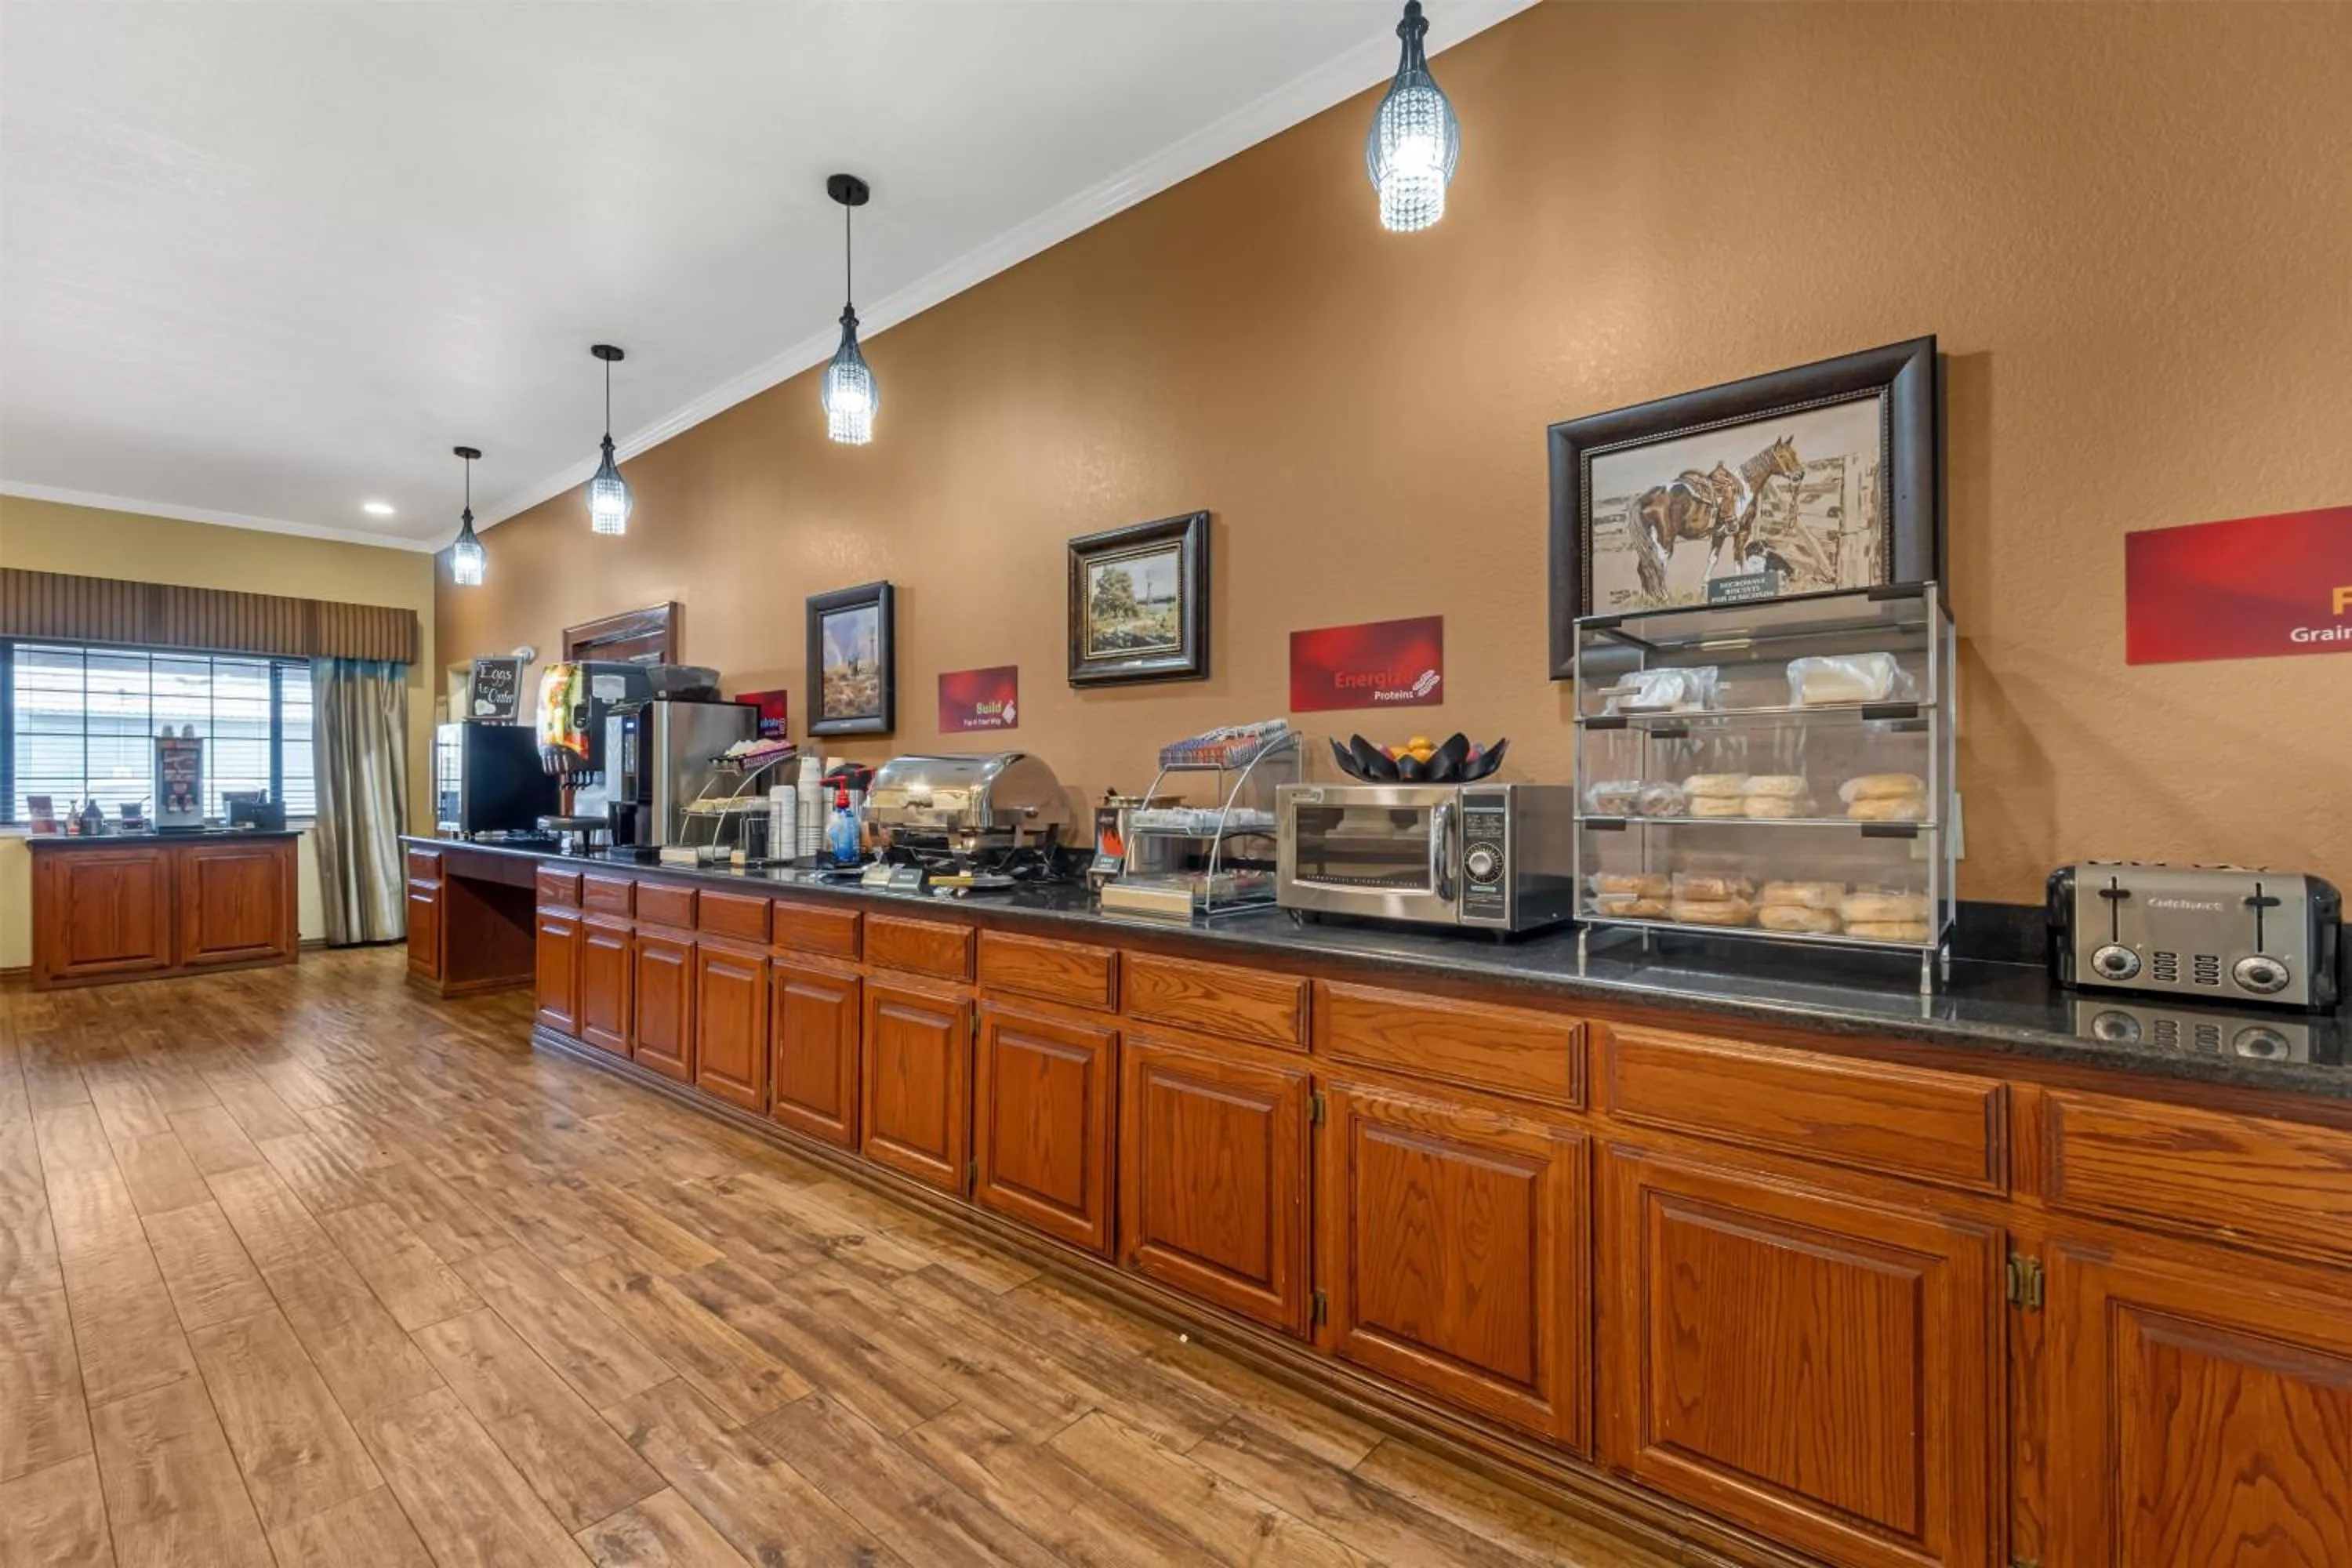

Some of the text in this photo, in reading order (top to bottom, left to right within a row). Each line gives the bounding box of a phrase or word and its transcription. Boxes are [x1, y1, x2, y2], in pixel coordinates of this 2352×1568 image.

[478, 664, 512, 687] Eggs
[1335, 667, 1414, 689] Energize
[1374, 690, 1414, 700] Proteins
[976, 701, 1002, 714] Build
